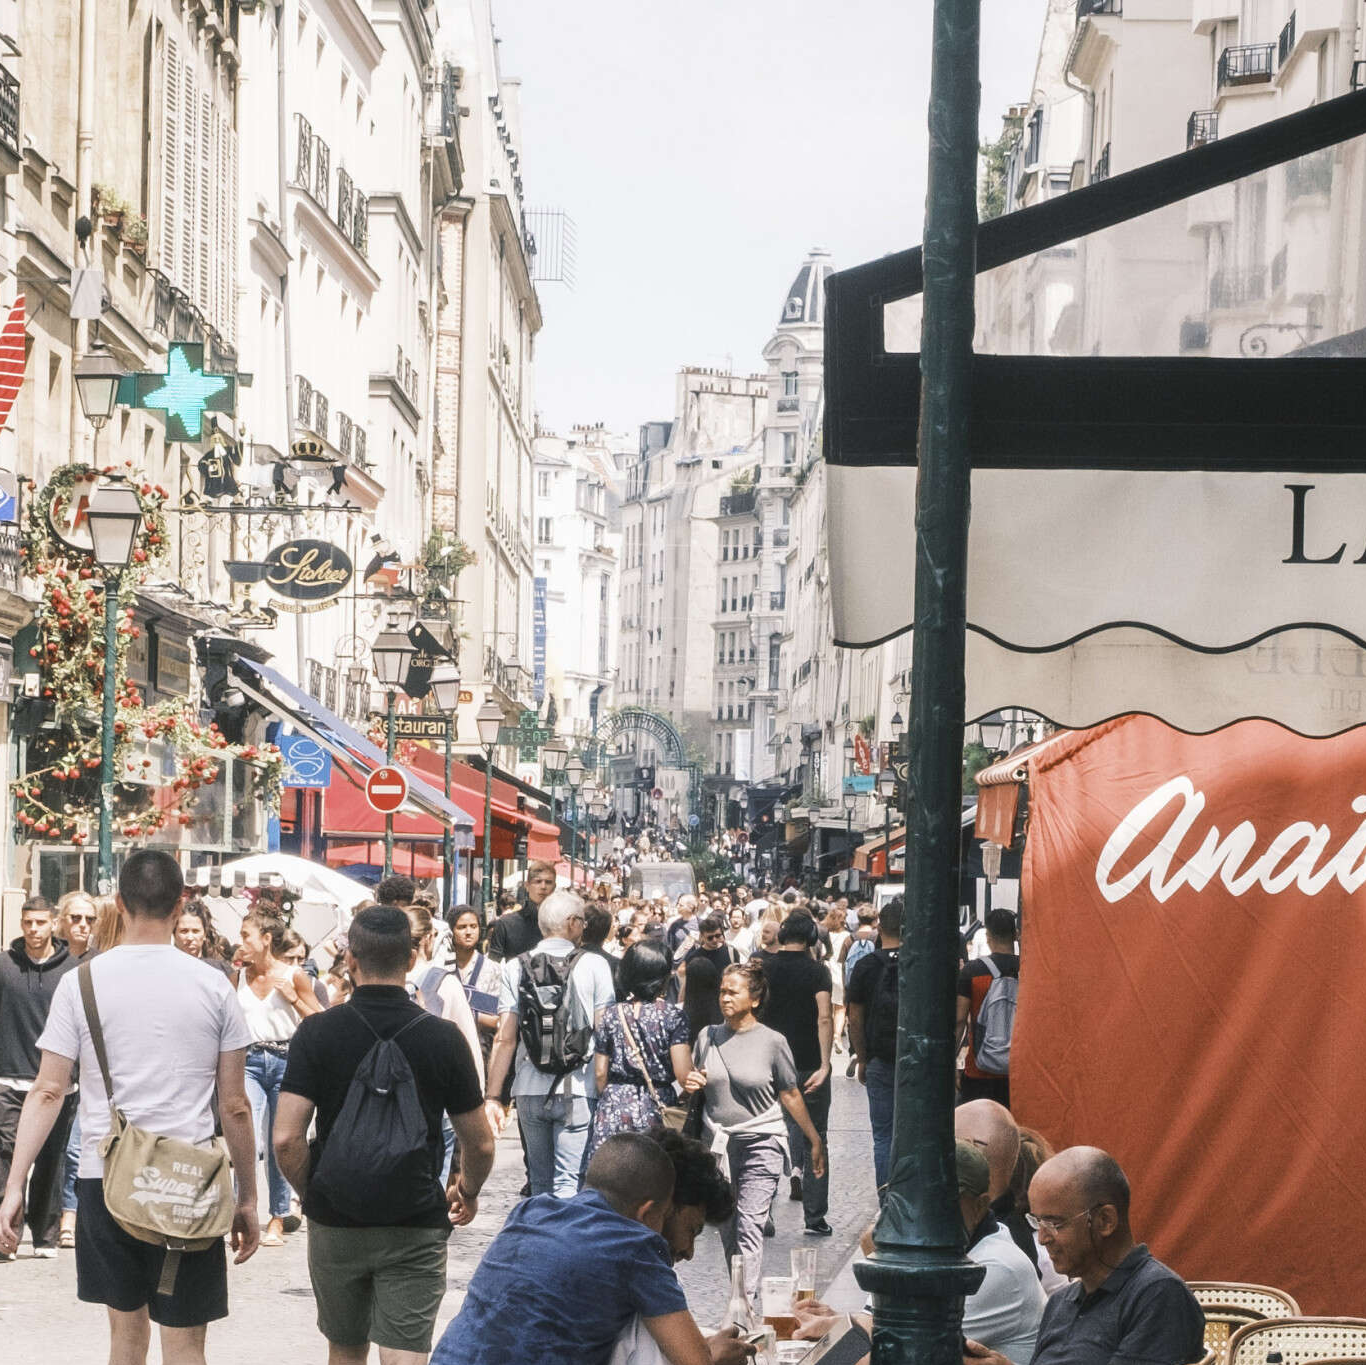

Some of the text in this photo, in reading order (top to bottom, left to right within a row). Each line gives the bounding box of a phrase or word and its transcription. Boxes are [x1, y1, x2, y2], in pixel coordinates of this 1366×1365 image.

[267, 547, 349, 587] Stohrer
[375, 716, 446, 736] Restauran
[172, 1162, 204, 1178] REAL
